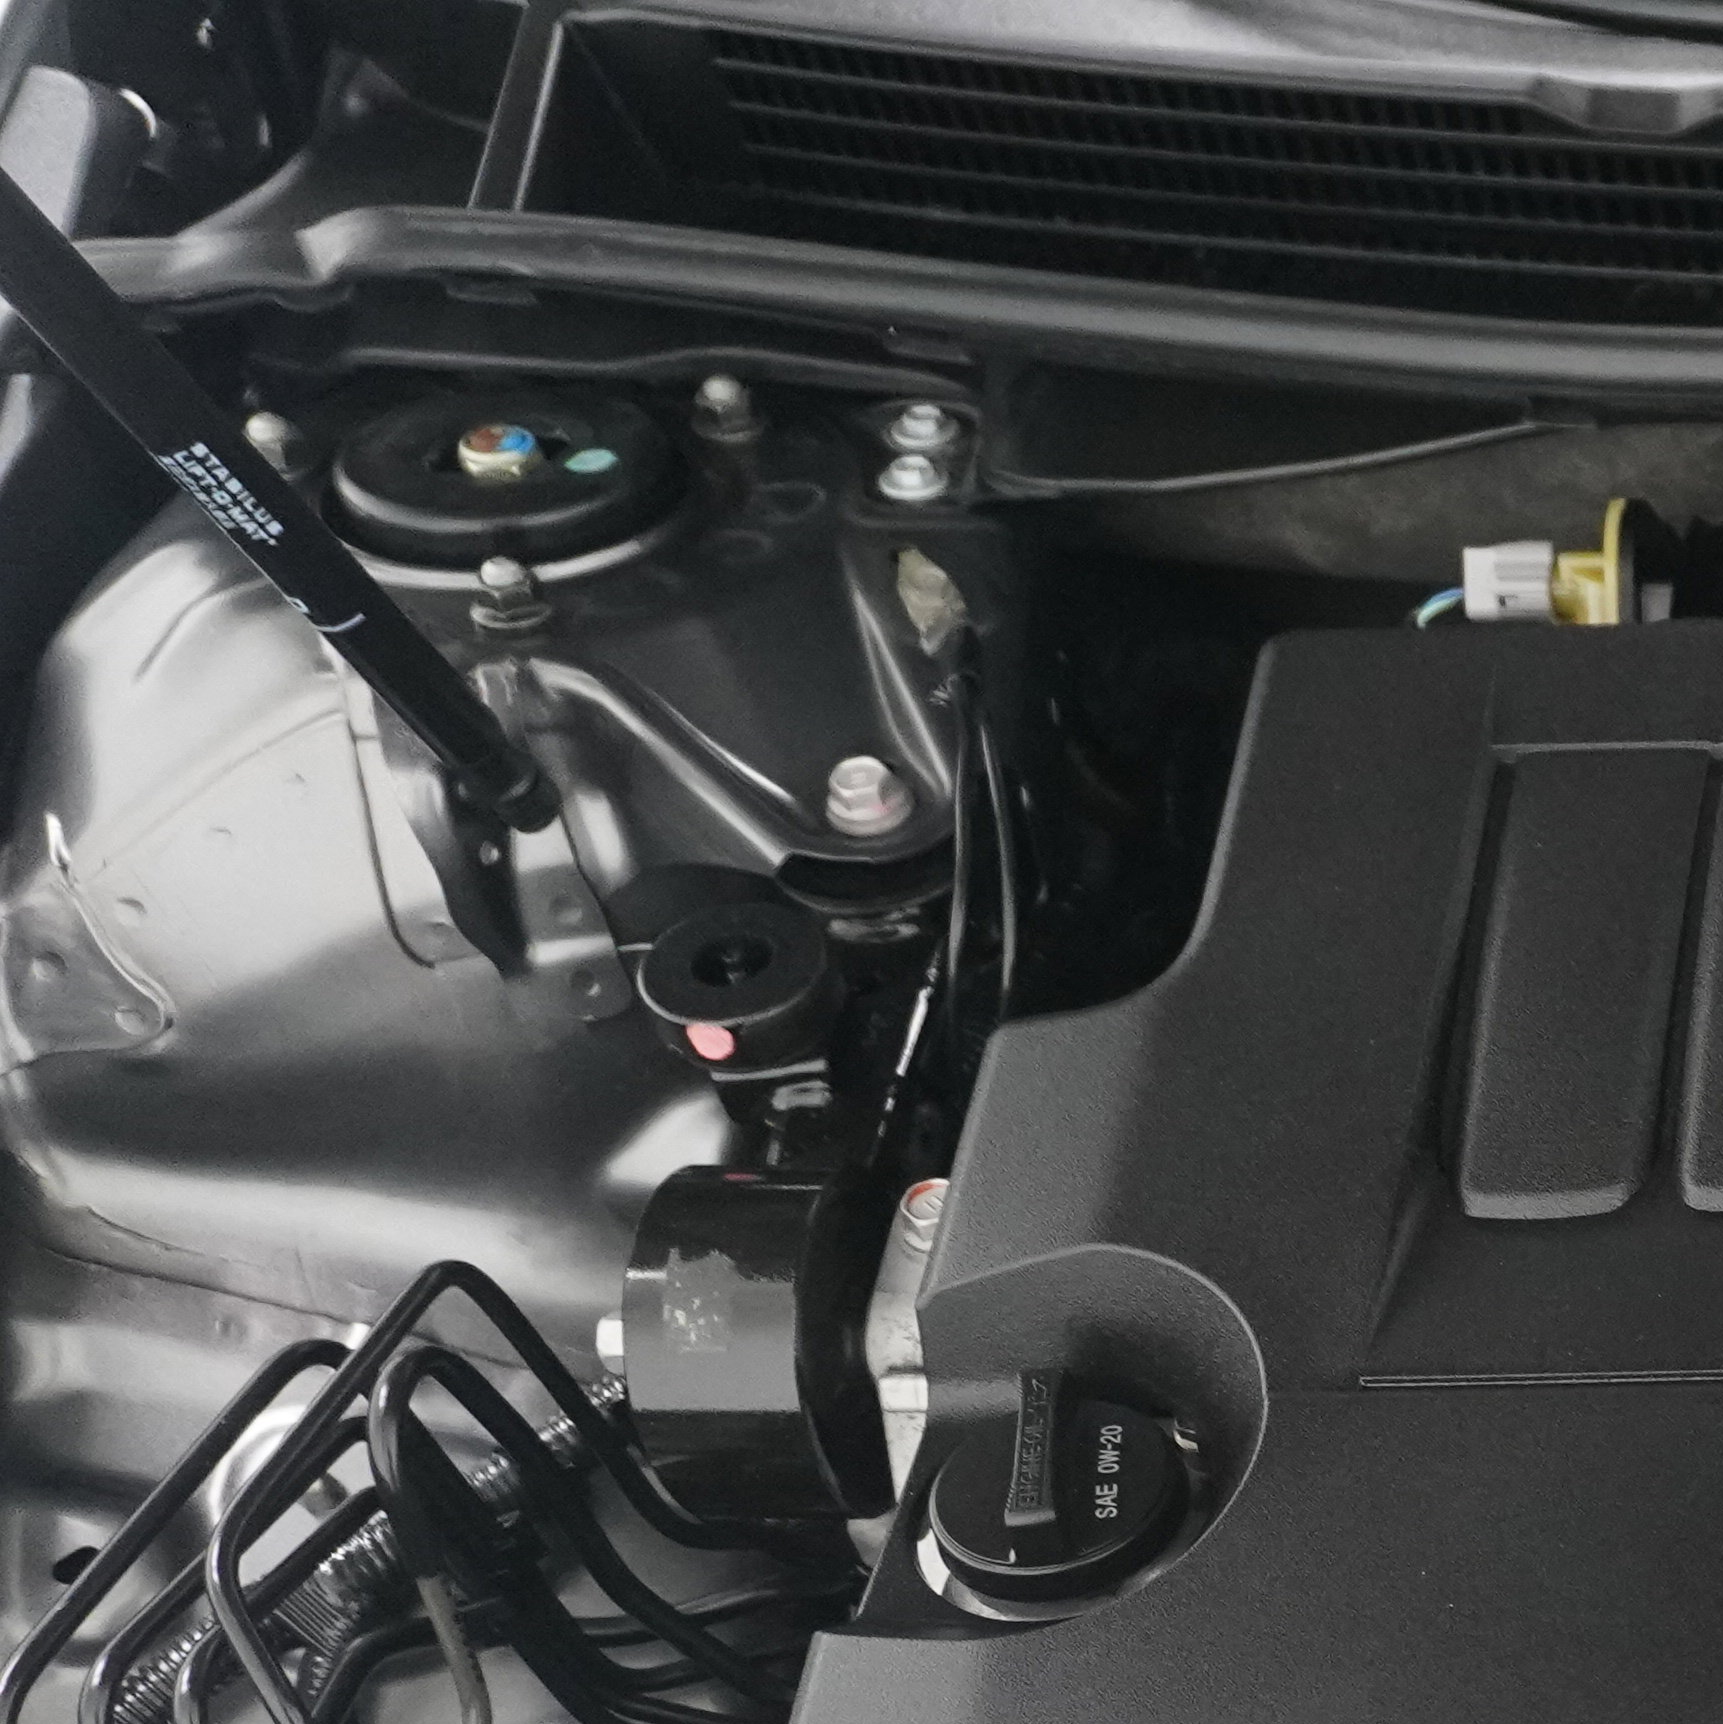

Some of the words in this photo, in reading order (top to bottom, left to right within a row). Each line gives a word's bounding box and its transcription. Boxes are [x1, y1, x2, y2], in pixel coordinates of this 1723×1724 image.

[190, 441, 285, 537] STABILUS
[1096, 1424, 1124, 1475] 0W-20
[1094, 1482, 1119, 1520] SAE
